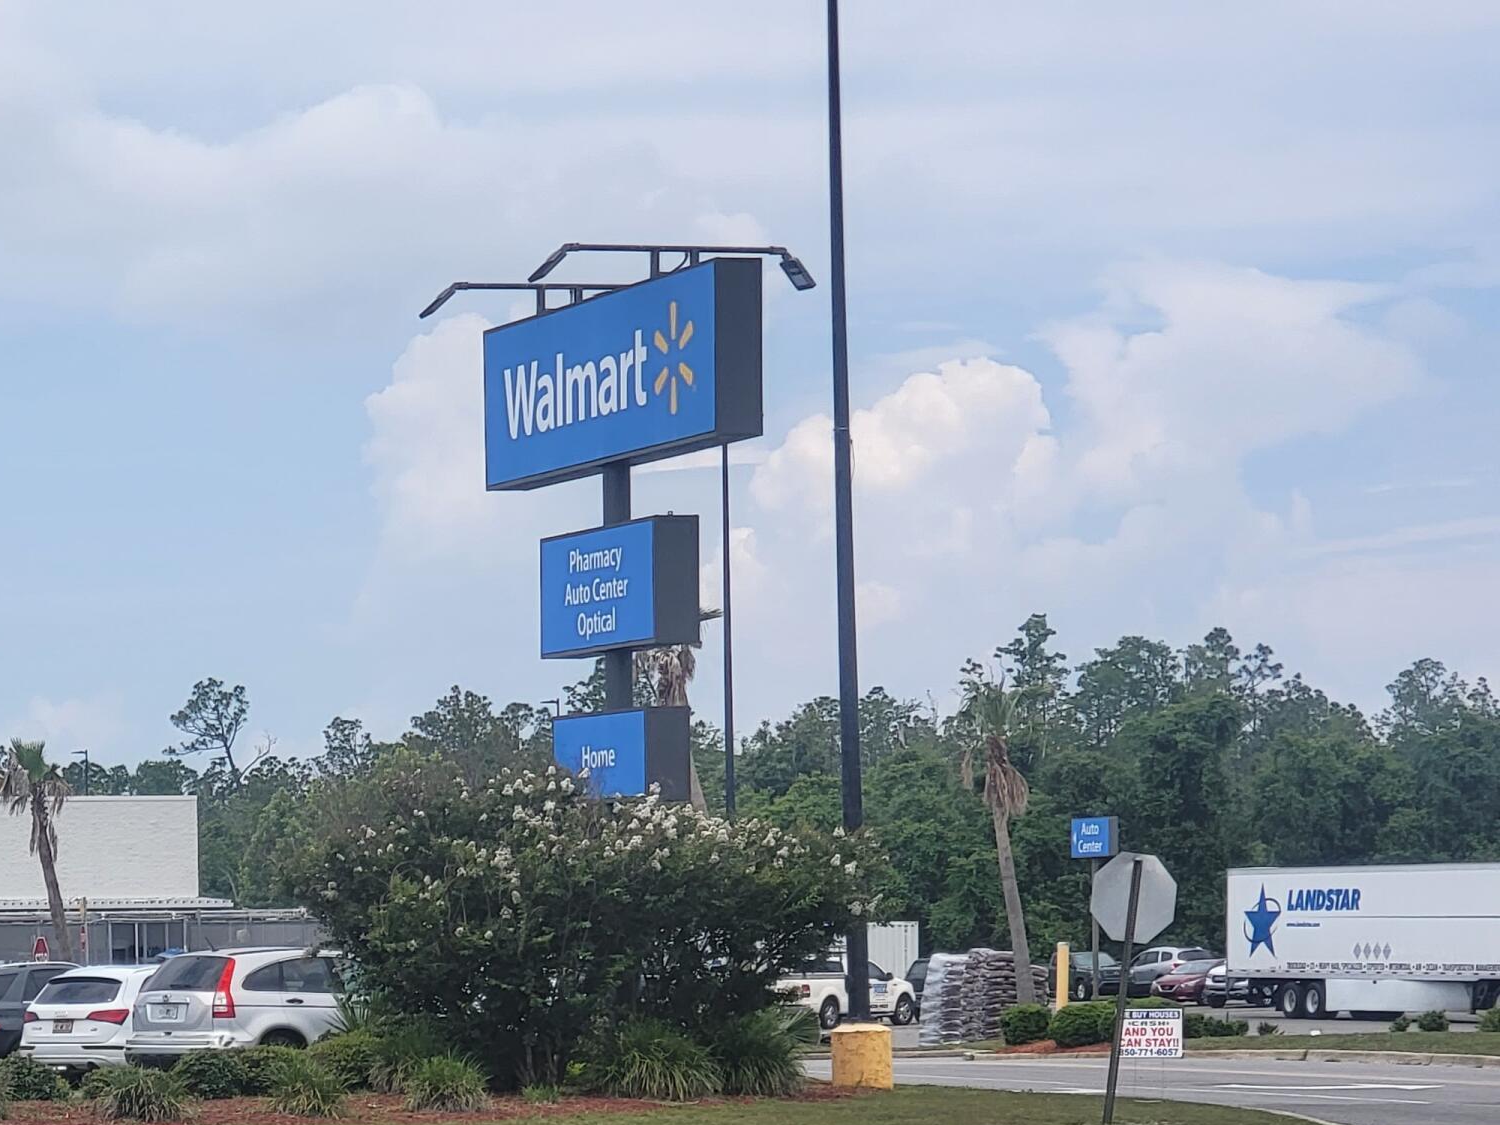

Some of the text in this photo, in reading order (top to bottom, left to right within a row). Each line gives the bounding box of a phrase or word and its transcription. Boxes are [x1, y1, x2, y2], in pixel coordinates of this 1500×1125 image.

[503, 329, 648, 440] Walmart
[569, 547, 622, 574] Pharmacy
[564, 577, 629, 606] Auto Center
[577, 605, 616, 641] Optical
[581, 745, 616, 769] Home
[1080, 822, 1100, 836] Auto
[1077, 839, 1103, 853] Center
[1287, 888, 1361, 911] LANDSTAR
[1124, 1027, 1174, 1037] AND YOU
[1145, 1038, 1179, 1048] STAY!!
